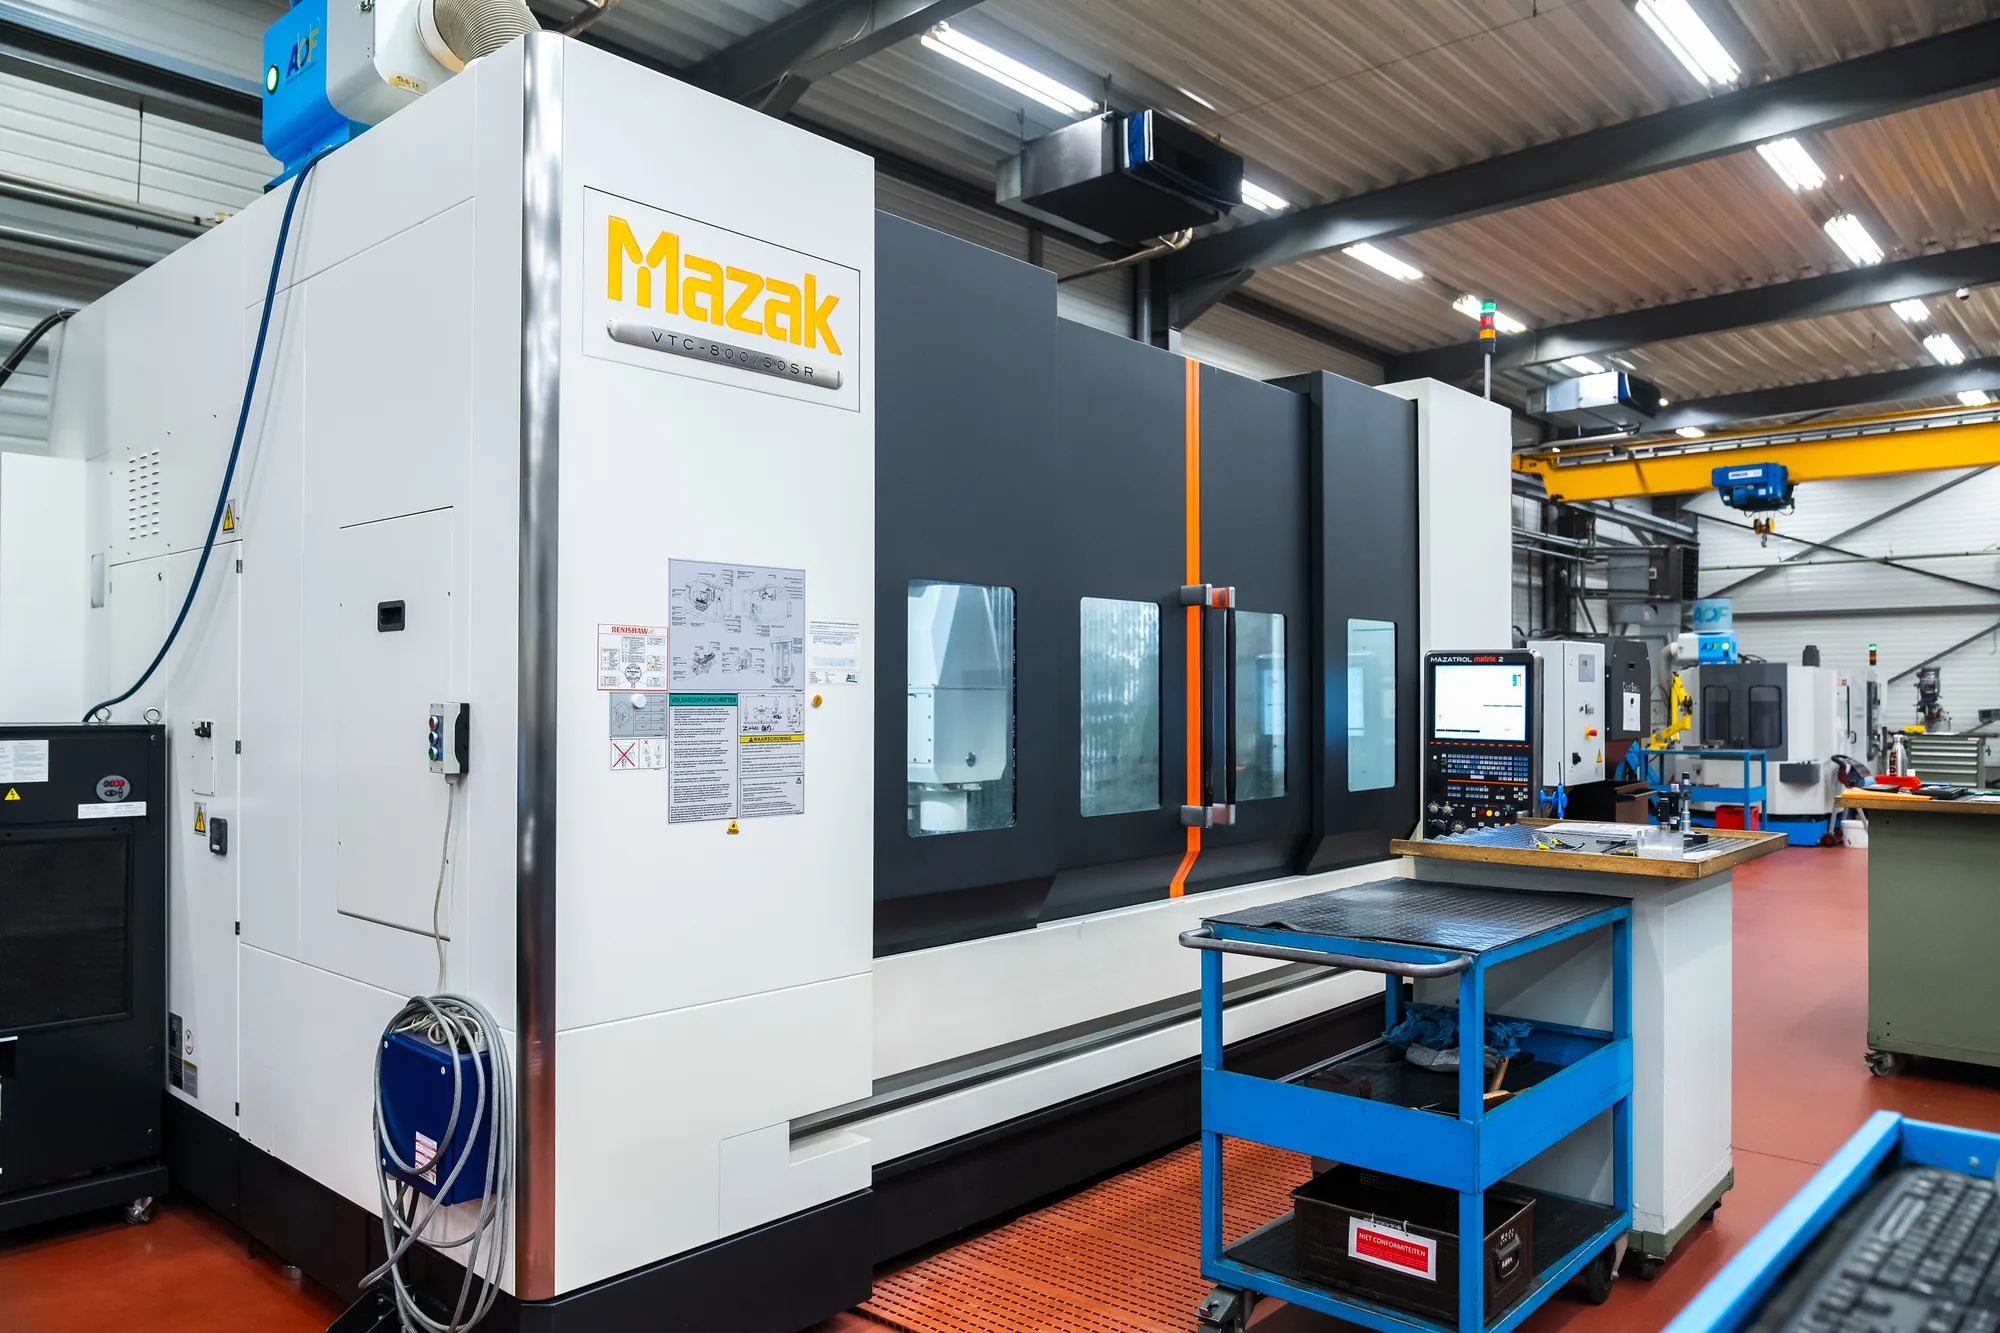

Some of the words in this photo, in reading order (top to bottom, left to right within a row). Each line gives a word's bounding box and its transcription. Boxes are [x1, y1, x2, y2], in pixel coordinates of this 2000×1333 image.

[607, 214, 843, 356] Mazak
[651, 330, 815, 378] VTC-800/30SR
[611, 626, 649, 635] RENISHAW
[1473, 655, 1497, 663] matrix
[1358, 1232, 1373, 1242] NIET
[1372, 1236, 1426, 1257] CONFORMITEITEN
